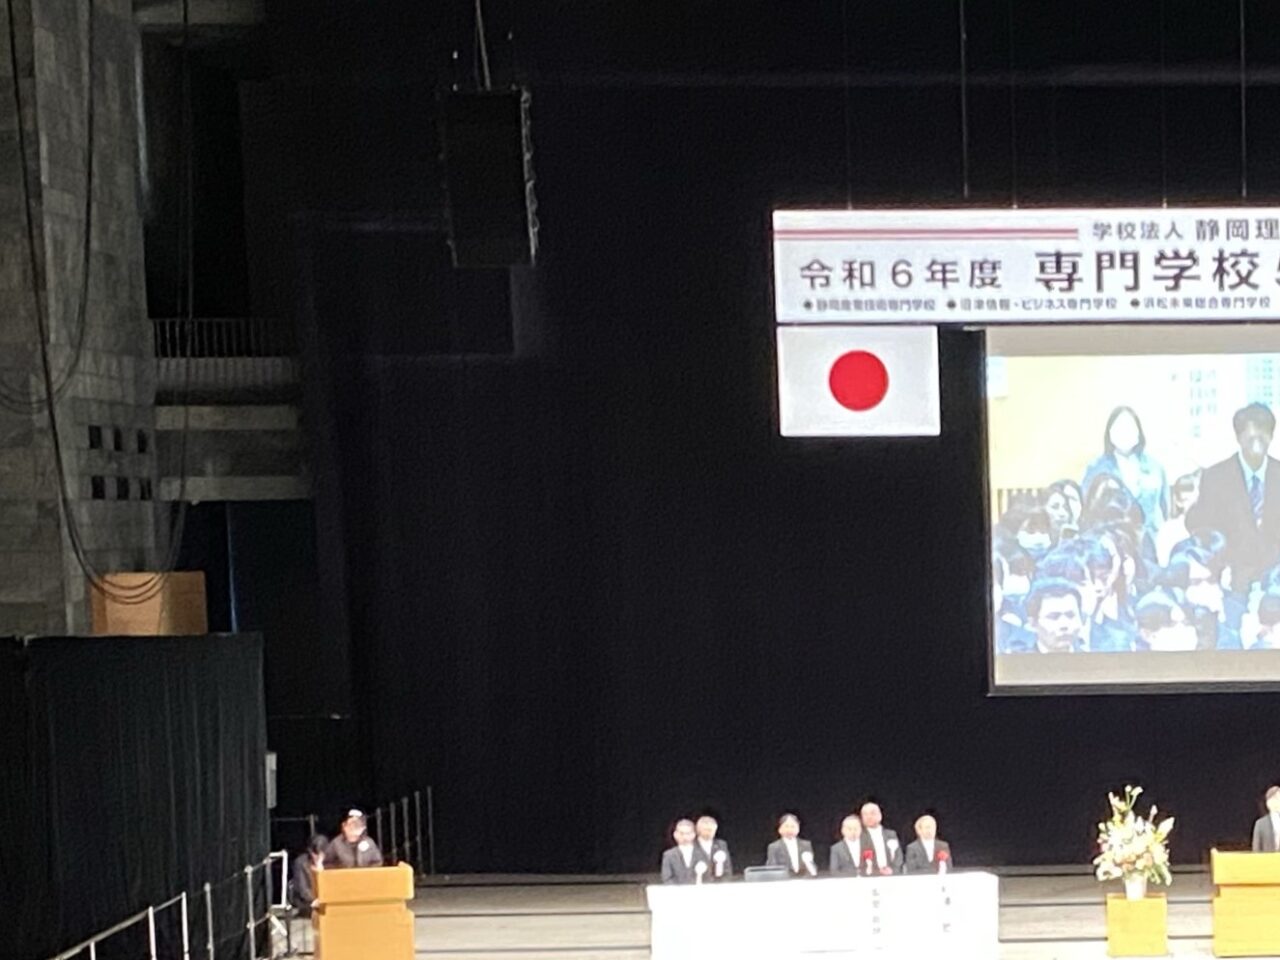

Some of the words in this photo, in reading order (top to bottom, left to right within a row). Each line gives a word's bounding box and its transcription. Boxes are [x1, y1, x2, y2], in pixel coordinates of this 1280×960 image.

[1092, 221, 1184, 241] 学校法人
[800, 258, 1002, 290] 令和6年度
